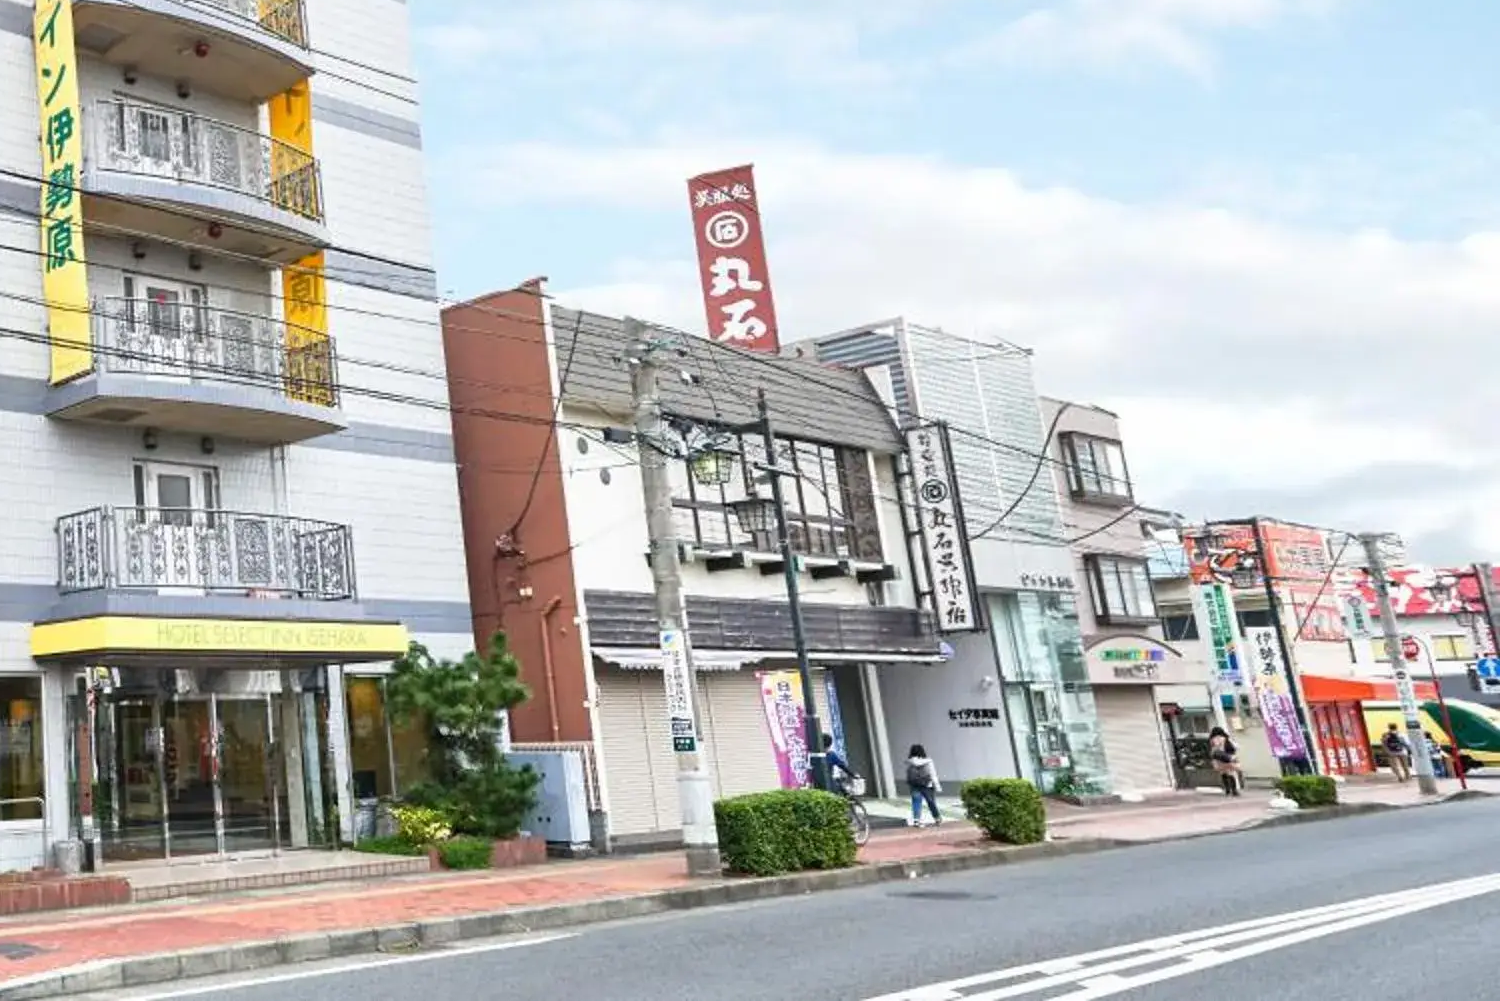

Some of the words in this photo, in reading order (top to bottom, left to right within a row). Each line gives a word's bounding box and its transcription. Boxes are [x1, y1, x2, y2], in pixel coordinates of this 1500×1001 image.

[709, 256, 767, 342] 丸石
[156, 623, 210, 645] HOTEL
[213, 624, 267, 646] SELECT
